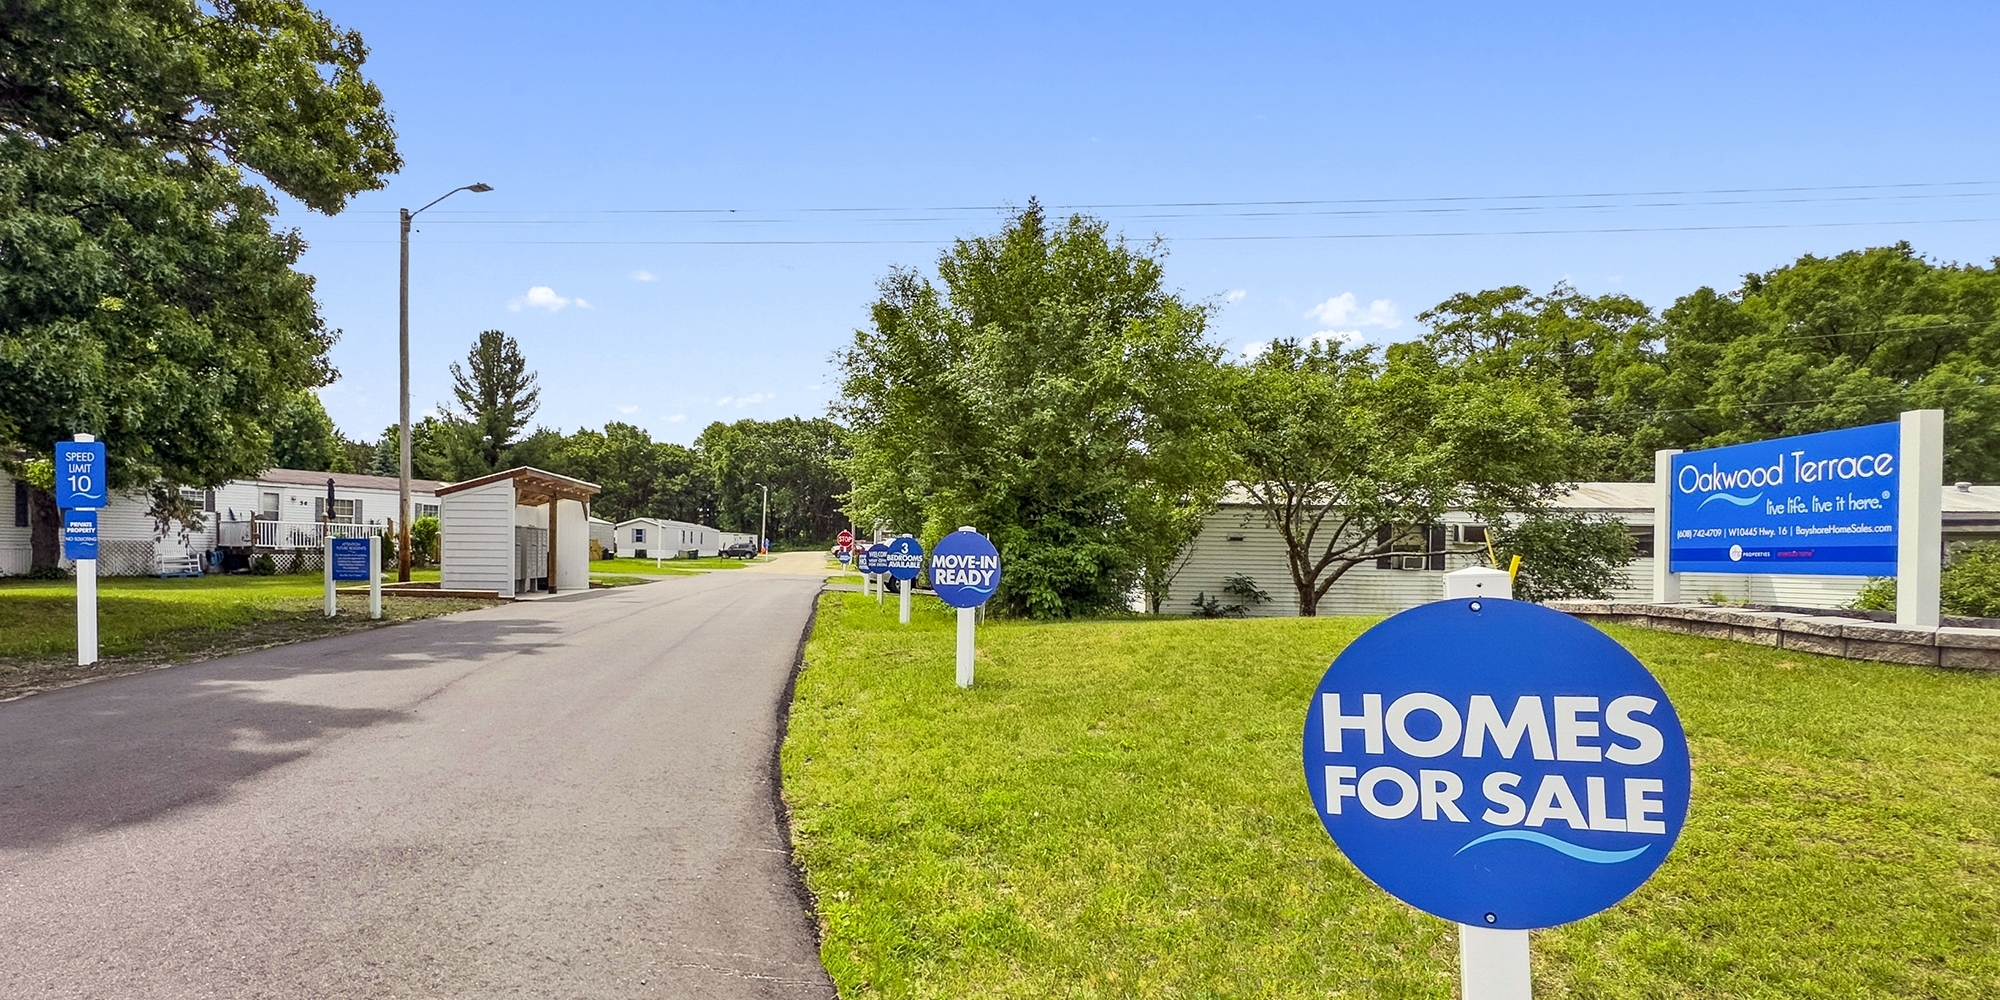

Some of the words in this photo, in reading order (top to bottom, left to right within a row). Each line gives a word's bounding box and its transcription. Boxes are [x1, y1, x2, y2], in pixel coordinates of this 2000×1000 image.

[65, 452, 95, 463] SPEED
[69, 464, 91, 473] LIMIT
[1678, 454, 1784, 494] Oakwood
[1791, 450, 1893, 484] Terrace
[67, 475, 92, 493] 10
[1766, 498, 1785, 516] live
[1787, 496, 1809, 514] life.
[1812, 496, 1833, 513] live
[1836, 496, 1846, 511] it
[1677, 529, 1692, 540] (608)
[1693, 528, 1723, 539] 742-4709
[1728, 527, 1758, 538] W10445
[1759, 526, 1776, 539] Hwy.
[1778, 526, 1788, 536] 16
[1795, 522, 1893, 537] BayshoreHomeSales.com
[901, 542, 909, 554] 3
[887, 554, 923, 562] BEDROOMS
[931, 555, 998, 570] MOVE-IN
[935, 569, 995, 586] READY
[1321, 691, 1665, 766] HOMES
[1324, 765, 1471, 823] FOR
[1481, 771, 1666, 834] SALE
